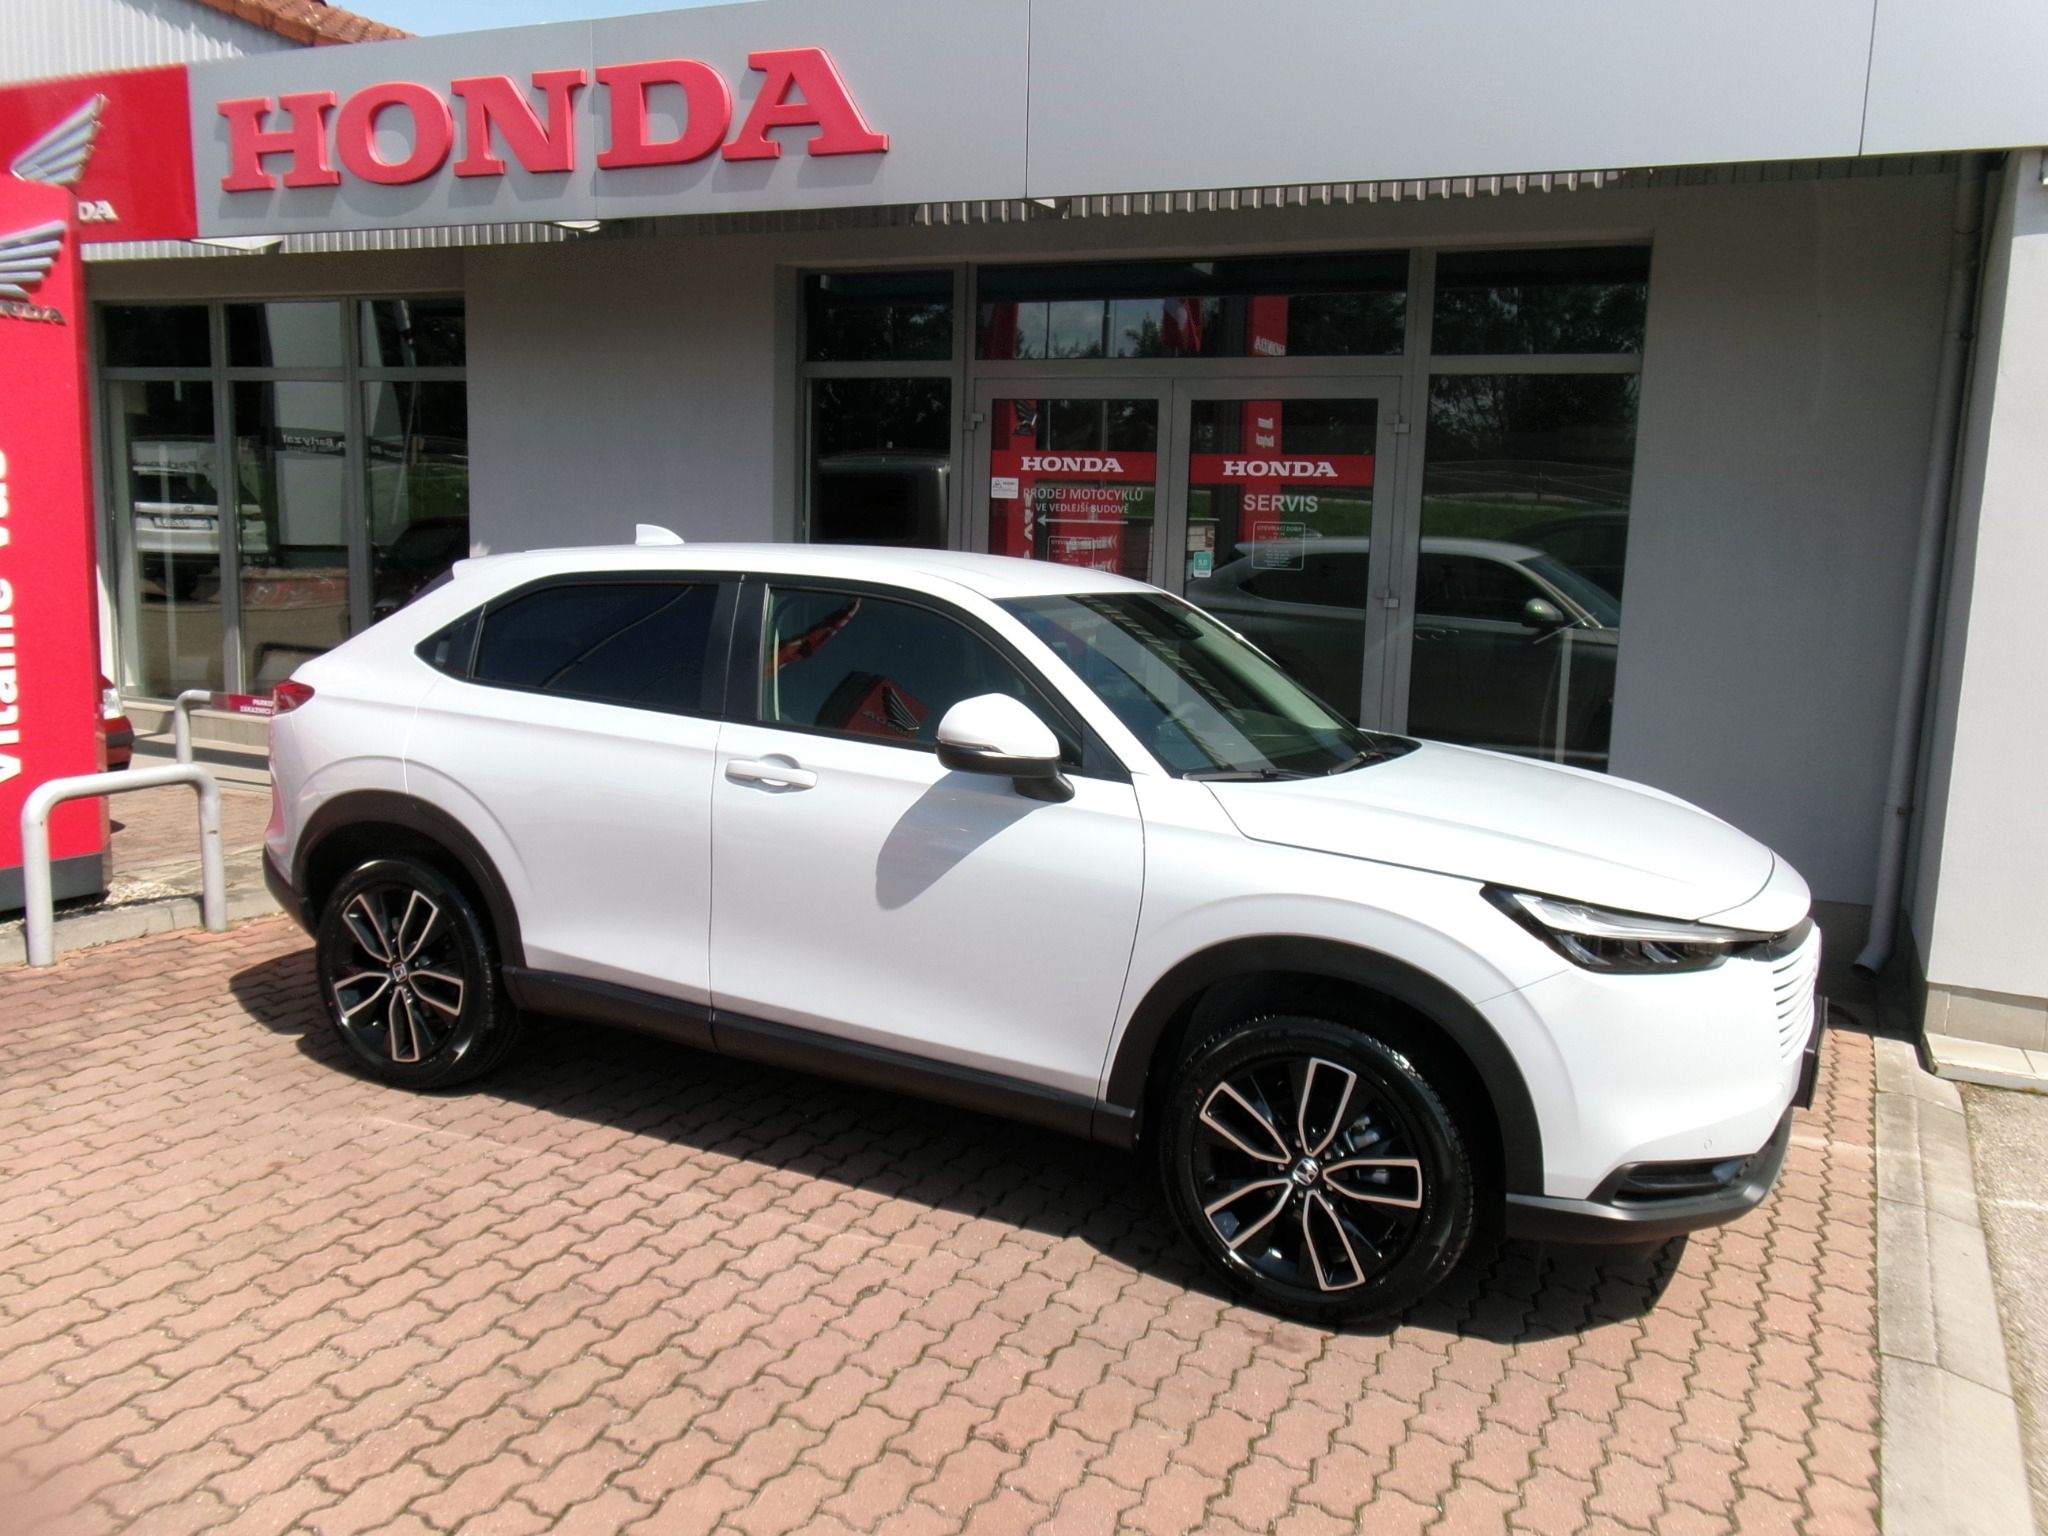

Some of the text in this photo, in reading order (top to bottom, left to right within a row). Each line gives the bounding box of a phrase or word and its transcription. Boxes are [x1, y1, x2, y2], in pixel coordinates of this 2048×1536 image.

[217, 46, 889, 193] HONDA
[1020, 456, 1125, 473] HONDA
[1222, 460, 1339, 478] HONDA
[1023, 487, 1066, 500] PRODEJ
[1069, 486, 1144, 502] MOTOCYKLŮ
[1035, 502, 1129, 514] VE VEDLEJŠÍ BUDOVĚ
[1243, 494, 1319, 513] SERVIS
